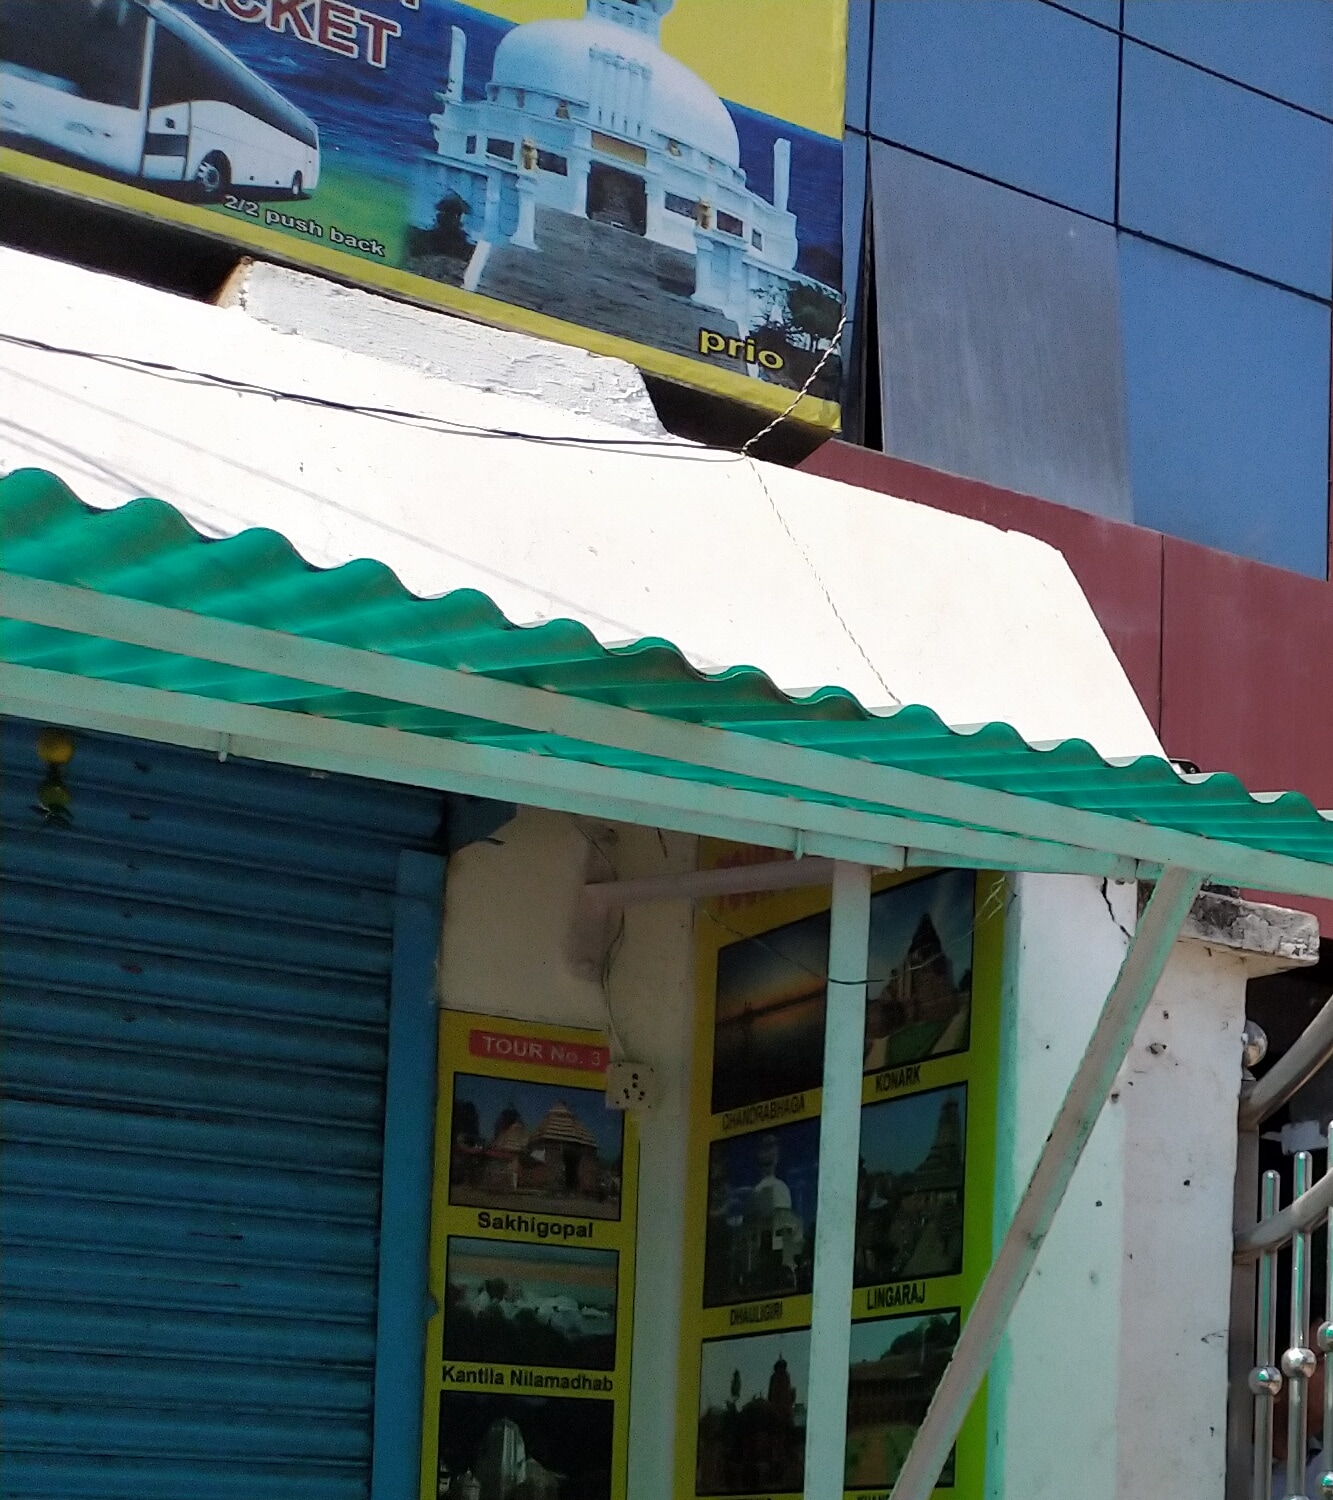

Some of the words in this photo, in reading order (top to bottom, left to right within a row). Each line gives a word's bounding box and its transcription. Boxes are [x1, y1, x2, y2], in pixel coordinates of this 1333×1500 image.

[224, 193, 260, 217] 2/2
[265, 206, 323, 239] push
[328, 225, 385, 255] back
[699, 327, 786, 371] prio
[483, 1036, 543, 1058] TOUR
[551, 1046, 583, 1064] No.
[592, 1051, 600, 1066] 3
[876, 1065, 921, 1093] KONARK
[478, 1211, 594, 1239] Sakhigopal
[867, 1284, 926, 1310] LINGARAJ
[510, 1370, 614, 1392] Nilamadhab
